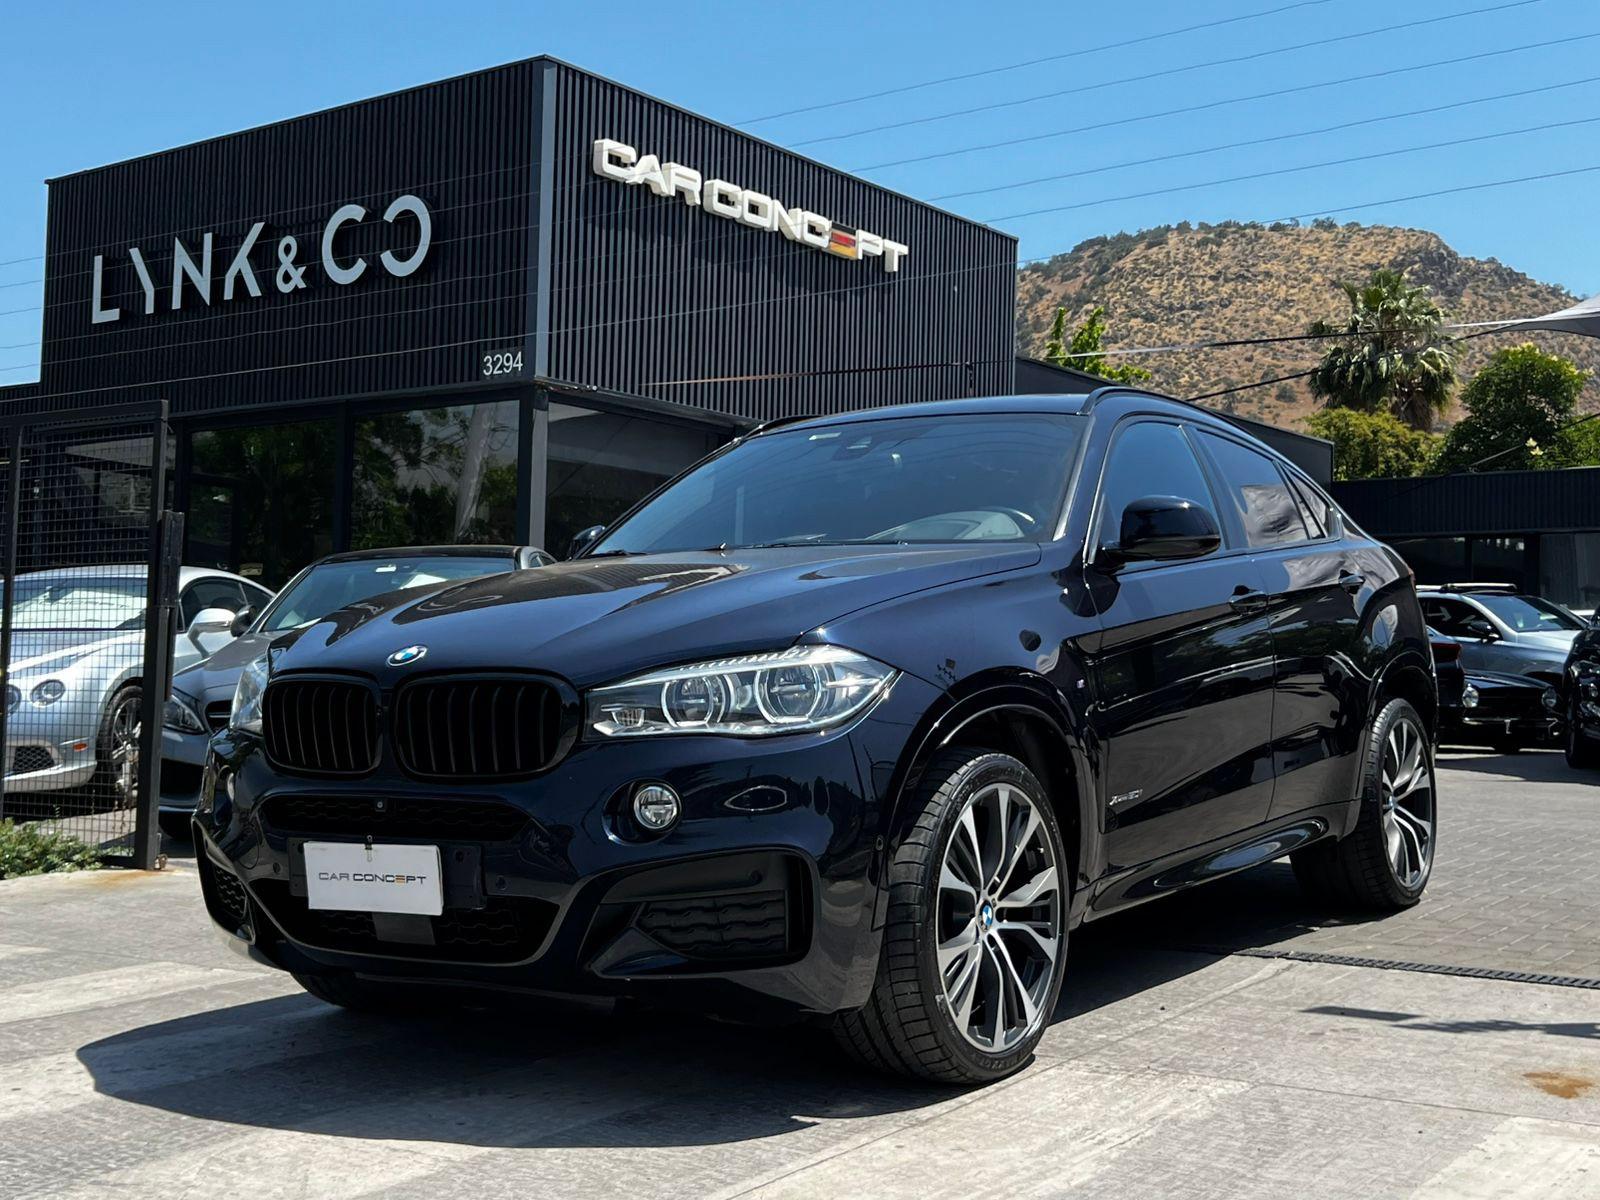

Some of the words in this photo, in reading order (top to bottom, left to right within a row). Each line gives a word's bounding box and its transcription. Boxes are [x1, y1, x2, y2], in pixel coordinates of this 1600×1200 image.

[593, 138, 702, 206] CAR
[703, 178, 909, 273] CONCEPT
[483, 351, 523, 376] 3294
[318, 872, 350, 881] CAR
[352, 873, 427, 885] CONCEPT
